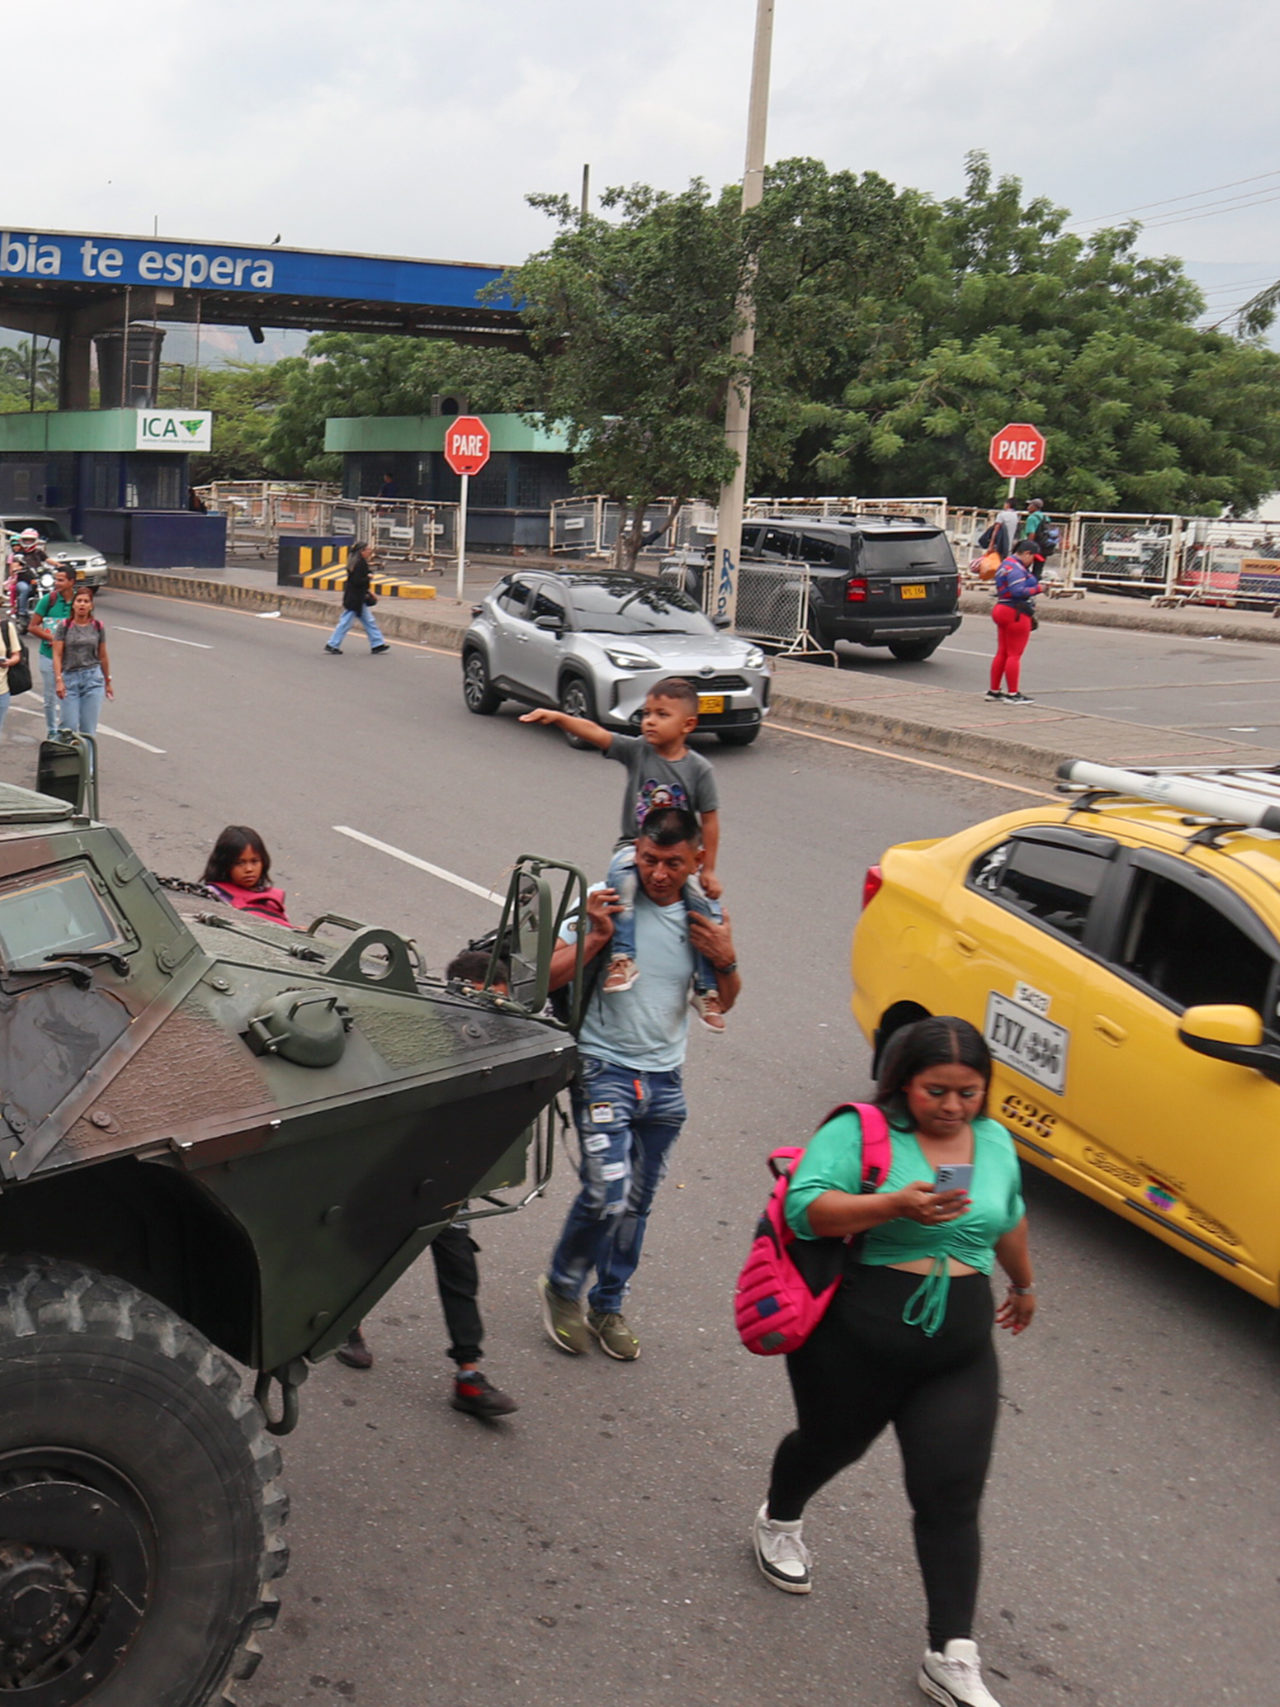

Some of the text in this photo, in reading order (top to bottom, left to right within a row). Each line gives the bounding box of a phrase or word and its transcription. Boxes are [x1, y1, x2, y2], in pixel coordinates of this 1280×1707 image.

[80, 240, 124, 278] te
[138, 250, 275, 288] espera
[142, 417, 178, 437] ICA
[452, 434, 484, 456] PARE
[998, 440, 1037, 461] PARE
